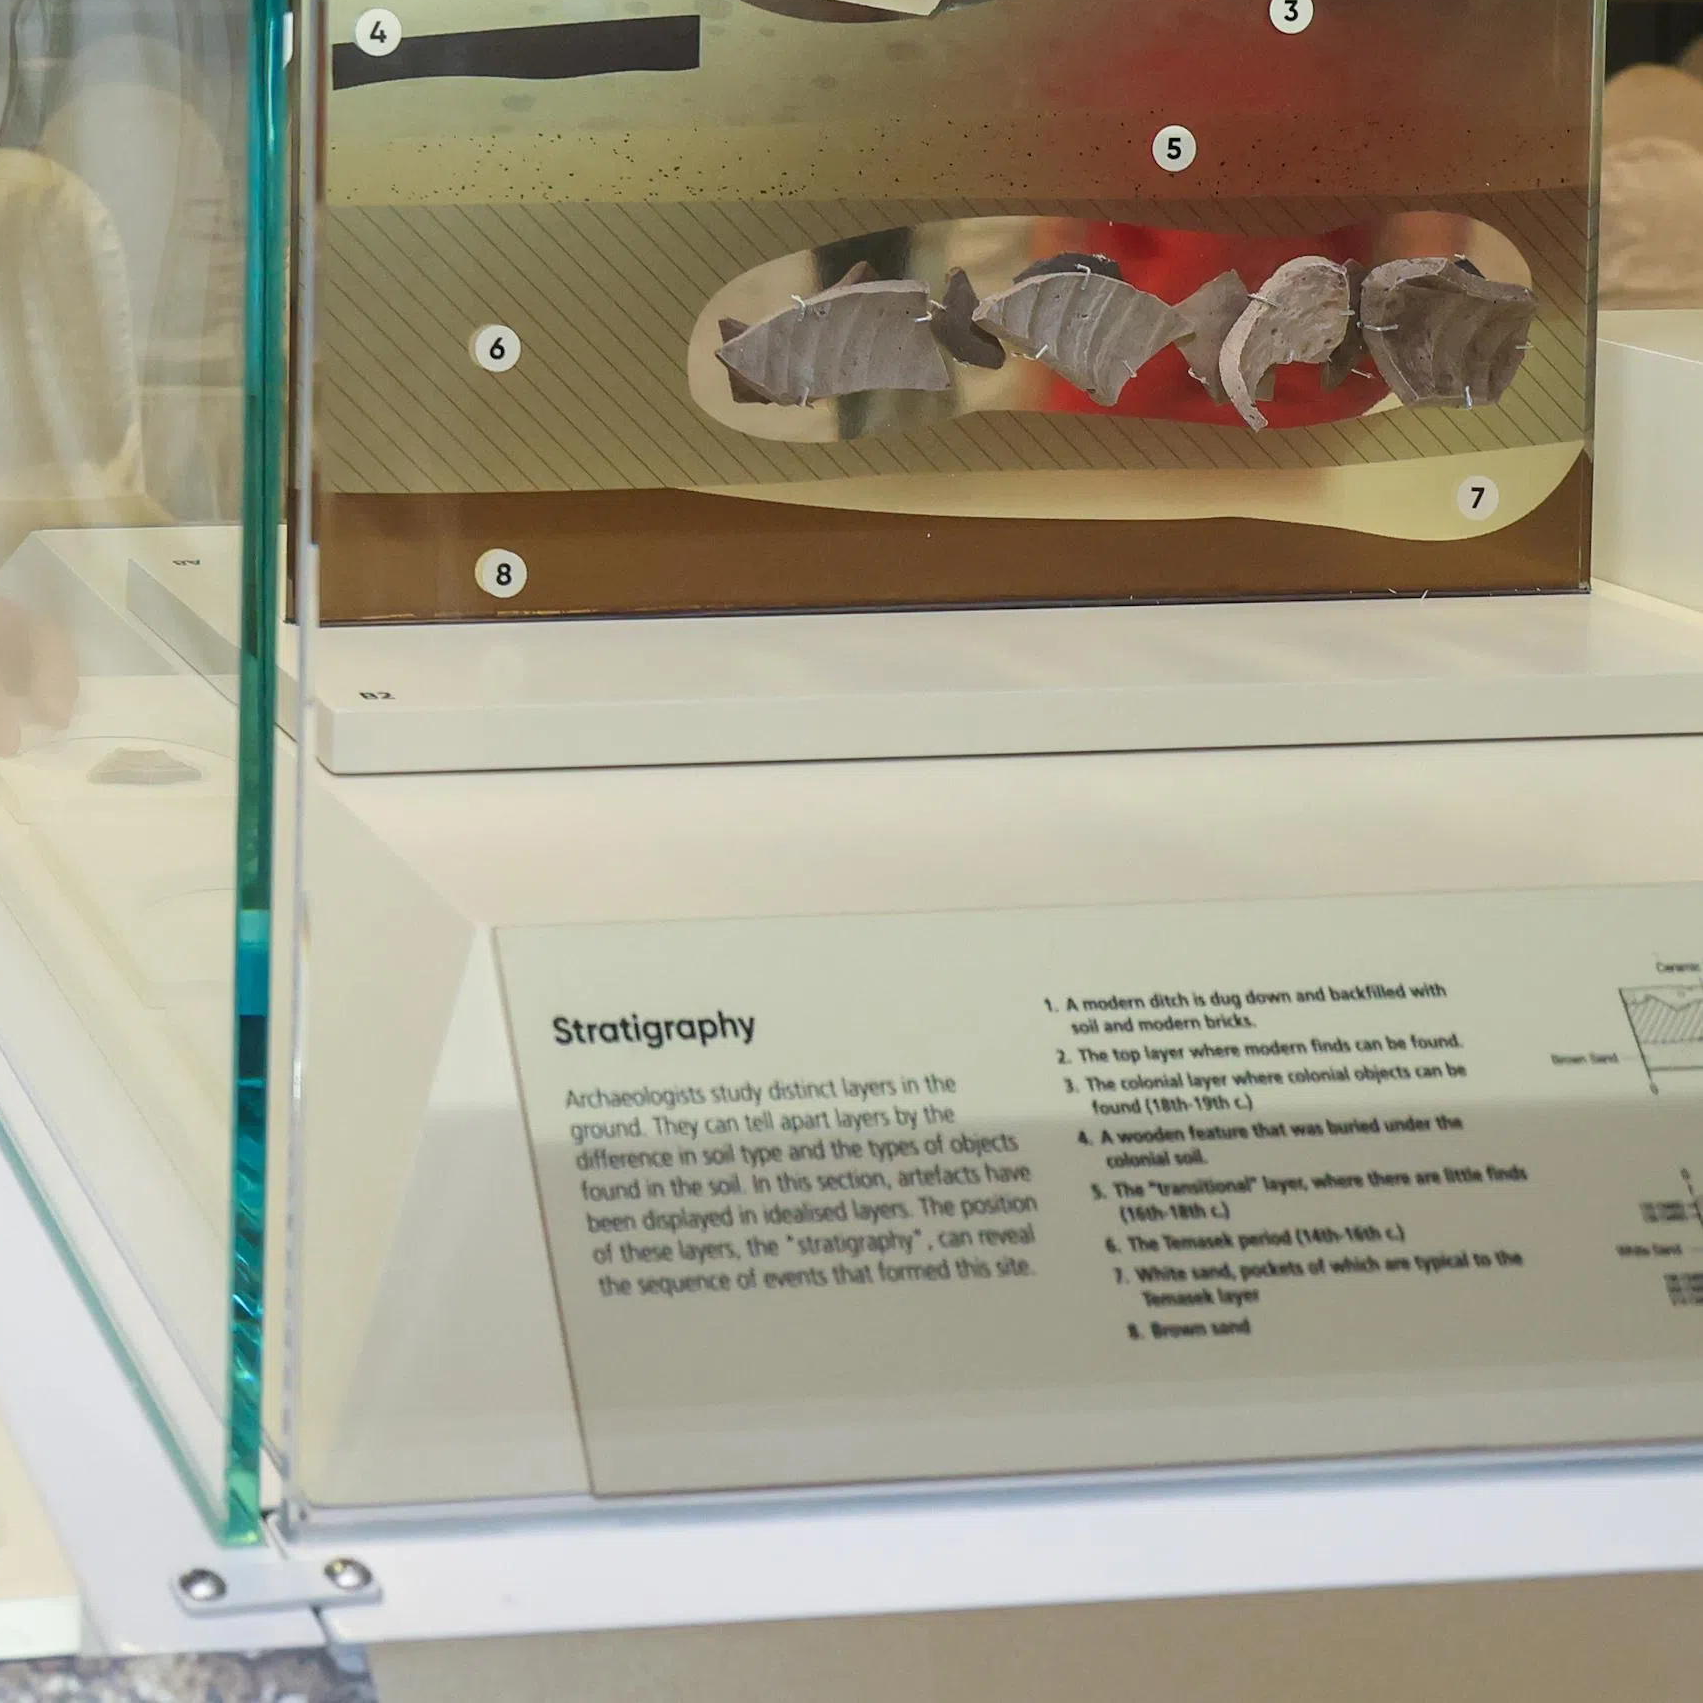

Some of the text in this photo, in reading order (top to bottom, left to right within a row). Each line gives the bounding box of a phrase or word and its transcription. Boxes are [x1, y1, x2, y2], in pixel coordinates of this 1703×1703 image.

[1284, 0, 1299, 22] 3
[369, 20, 388, 44] 4
[1166, 137, 1182, 160] 5
[489, 336, 506, 360] 6
[1471, 486, 1485, 509] 7
[496, 562, 513, 586] 8
[552, 1009, 756, 1051] Stratigraphy
[564, 1072, 957, 1112] Archaeologists study distinct layers in the
[652, 1114, 700, 1145] They
[703, 1118, 741, 1139] can
[743, 1109, 776, 1139] tell
[778, 1109, 832, 1139] apart
[833, 1106, 892, 1137] layers
[892, 1103, 919, 1134] by
[922, 1103, 956, 1132] the
[575, 1132, 1020, 1173] difference in soil type and the types of objects
[579, 1177, 642, 1203] found
[645, 1176, 666, 1199] in
[668, 1174, 704, 1199] the
[751, 1172, 772, 1195] In
[775, 1170, 814, 1195] this
[897, 1164, 982, 1189] artefacts
[983, 1162, 1032, 1184] have
[585, 1210, 638, 1235] been
[641, 1203, 735, 1236] displayed
[738, 1203, 759, 1227] in
[762, 1198, 849, 1227] idealised
[916, 1195, 956, 1219] The
[959, 1192, 1039, 1221] position
[591, 1241, 614, 1266] of
[618, 1240, 674, 1265] these
[745, 1234, 780, 1259] the
[938, 1231, 974, 1253] can
[976, 1222, 1037, 1247] reveal
[597, 1273, 633, 1298] the
[636, 1271, 732, 1299] sequence
[735, 1266, 758, 1292] of
[762, 1266, 830, 1291] events
[831, 1262, 874, 1287] that
[876, 1258, 952, 1284] formed
[954, 1256, 993, 1281] this
